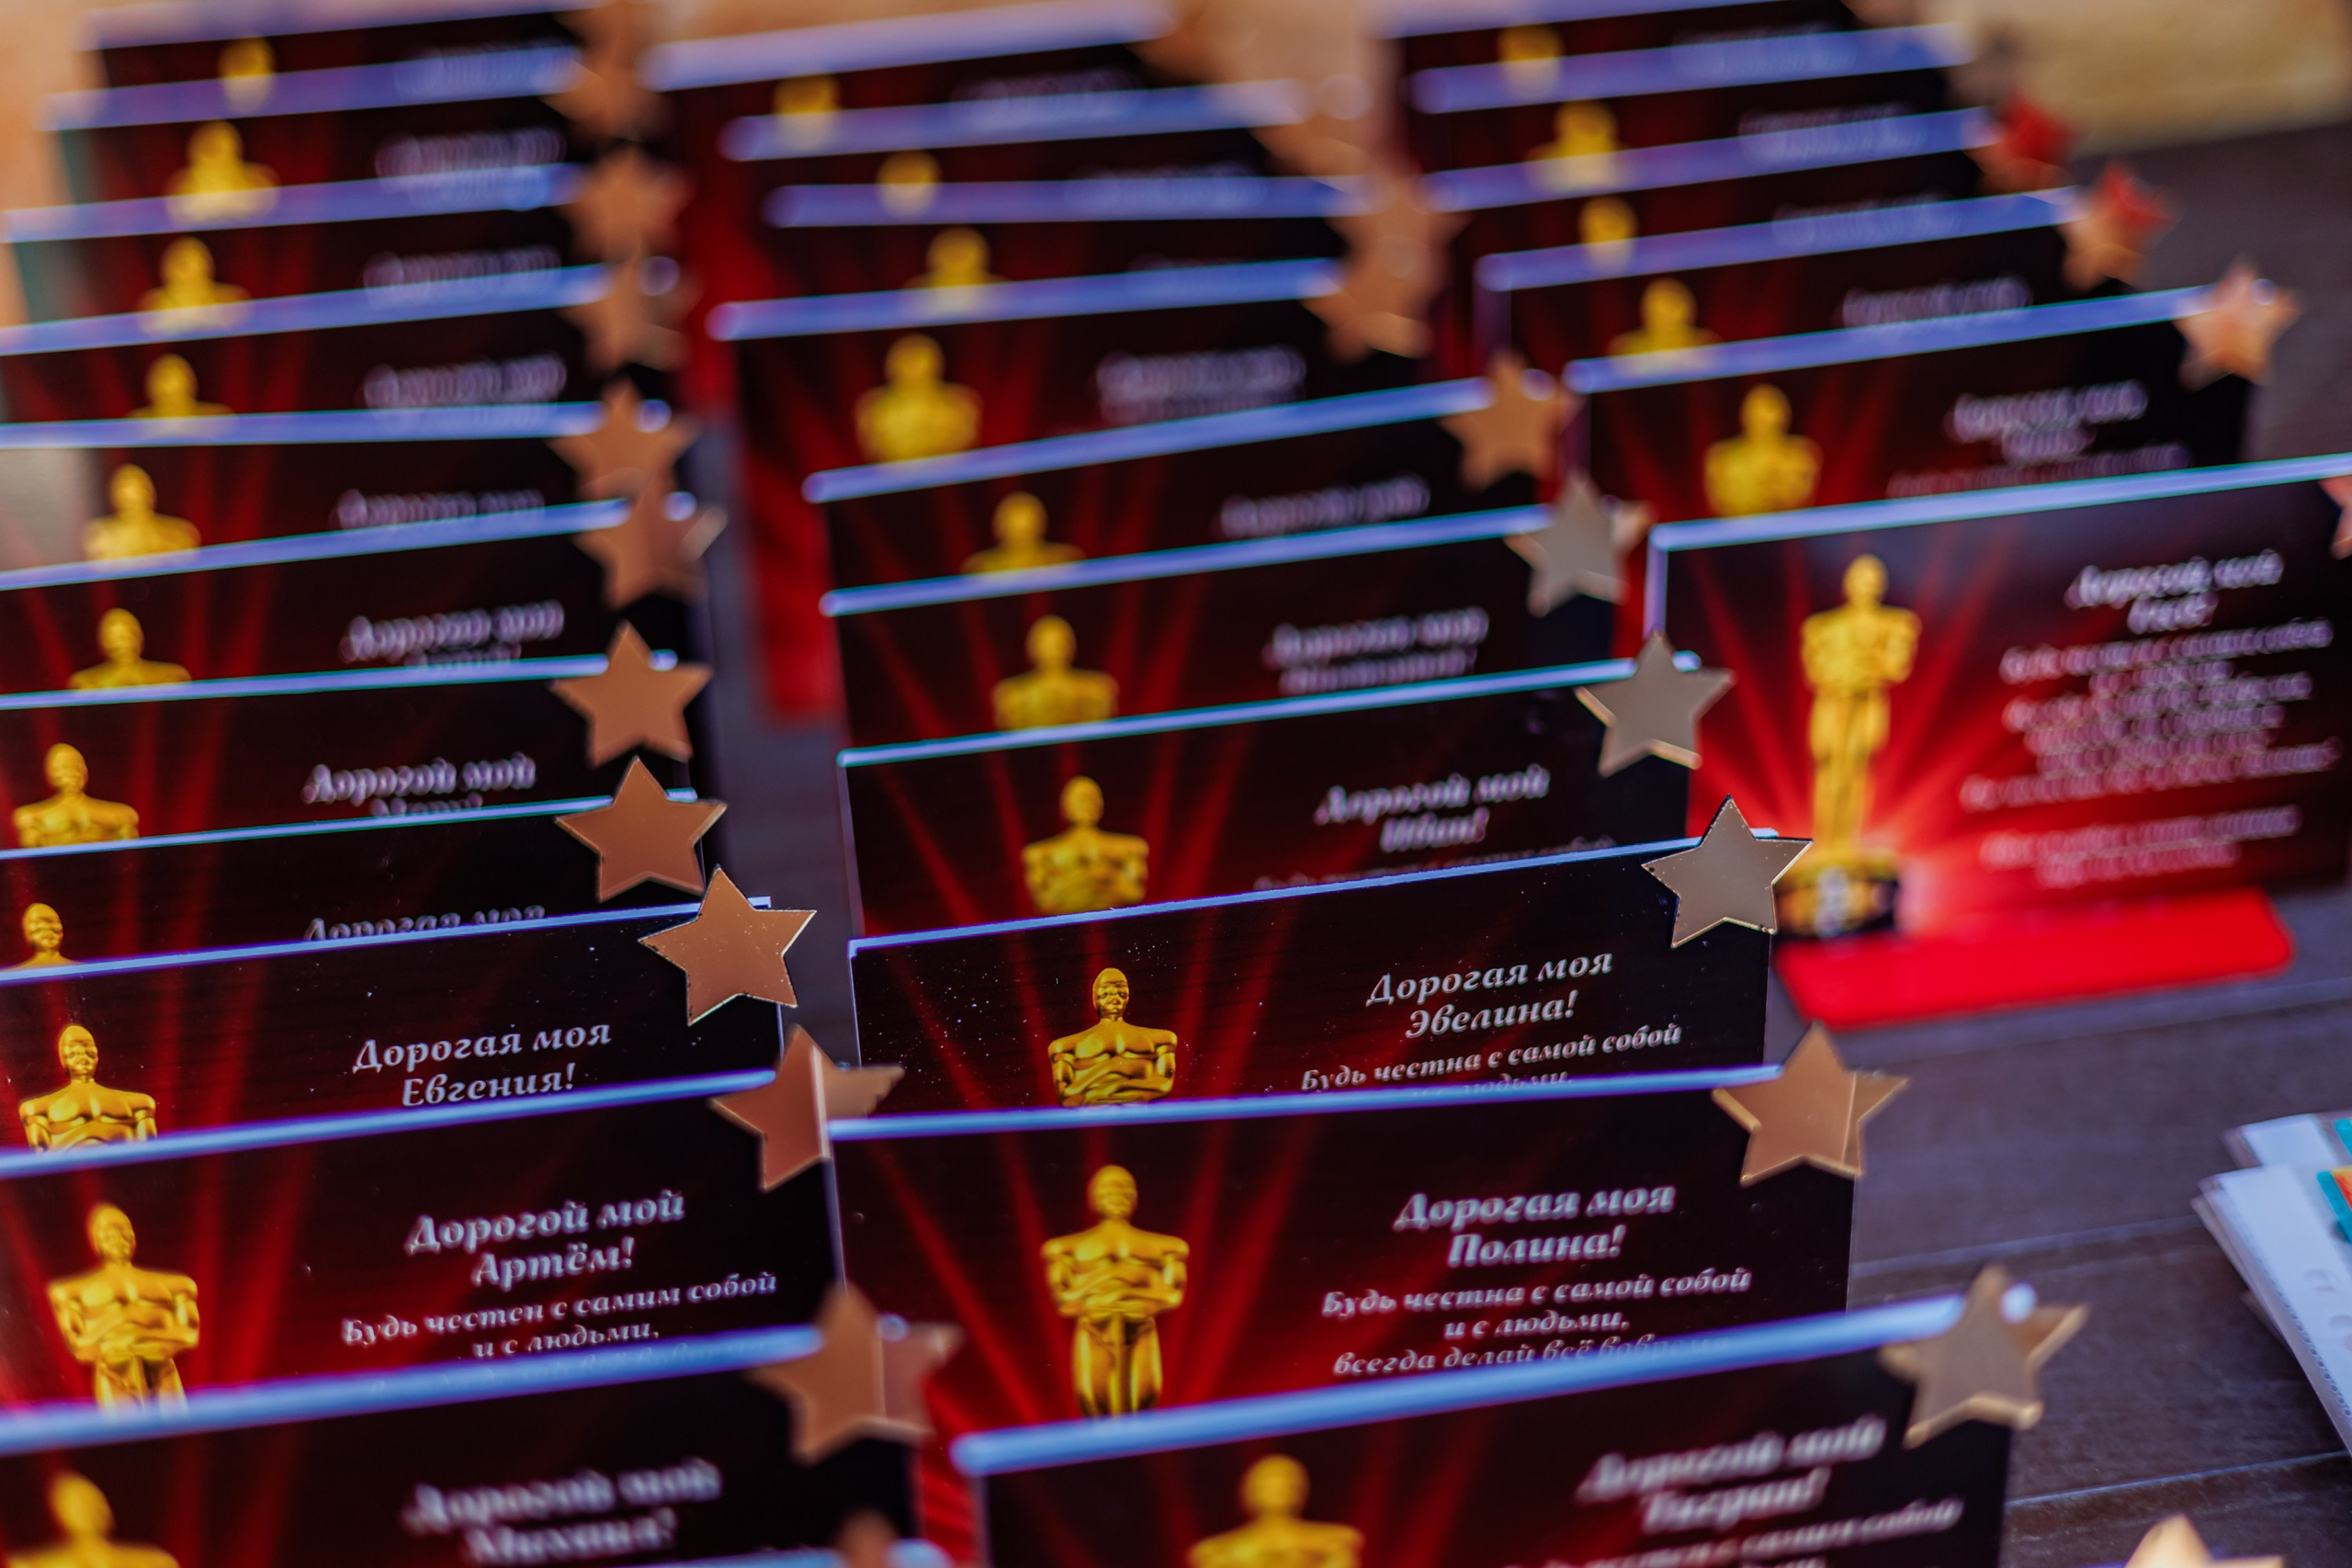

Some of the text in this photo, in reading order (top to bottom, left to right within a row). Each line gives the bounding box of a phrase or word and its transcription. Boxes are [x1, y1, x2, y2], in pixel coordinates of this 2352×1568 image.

[300, 757, 457, 807] Дорогой
[459, 751, 537, 791] мой
[1314, 763, 1551, 825] Дорогой мой
[1366, 952, 1613, 1007] Дорогая моя
[1406, 989, 1578, 1039] Эвелина!
[352, 1022, 611, 1074] Дорогая моя
[1301, 1022, 1682, 1093] Будь честна с самой собой
[402, 1064, 575, 1108] Евгения!
[405, 1189, 684, 1255] Дорогой мой
[1393, 1185, 1676, 1233] Дорогая моя
[472, 1236, 635, 1292] Артём!
[1447, 1224, 1626, 1269] Полина!
[342, 1271, 777, 1346] Будь честен с самим собой
[1321, 1267, 1751, 1321] Будь честна с самой собой
[472, 1340, 494, 1358] и
[504, 1339, 518, 1356] с
[1443, 1309, 1630, 1340] и с людьми,
[1333, 1348, 1435, 1376] всегда
[1443, 1343, 1535, 1368] делай
